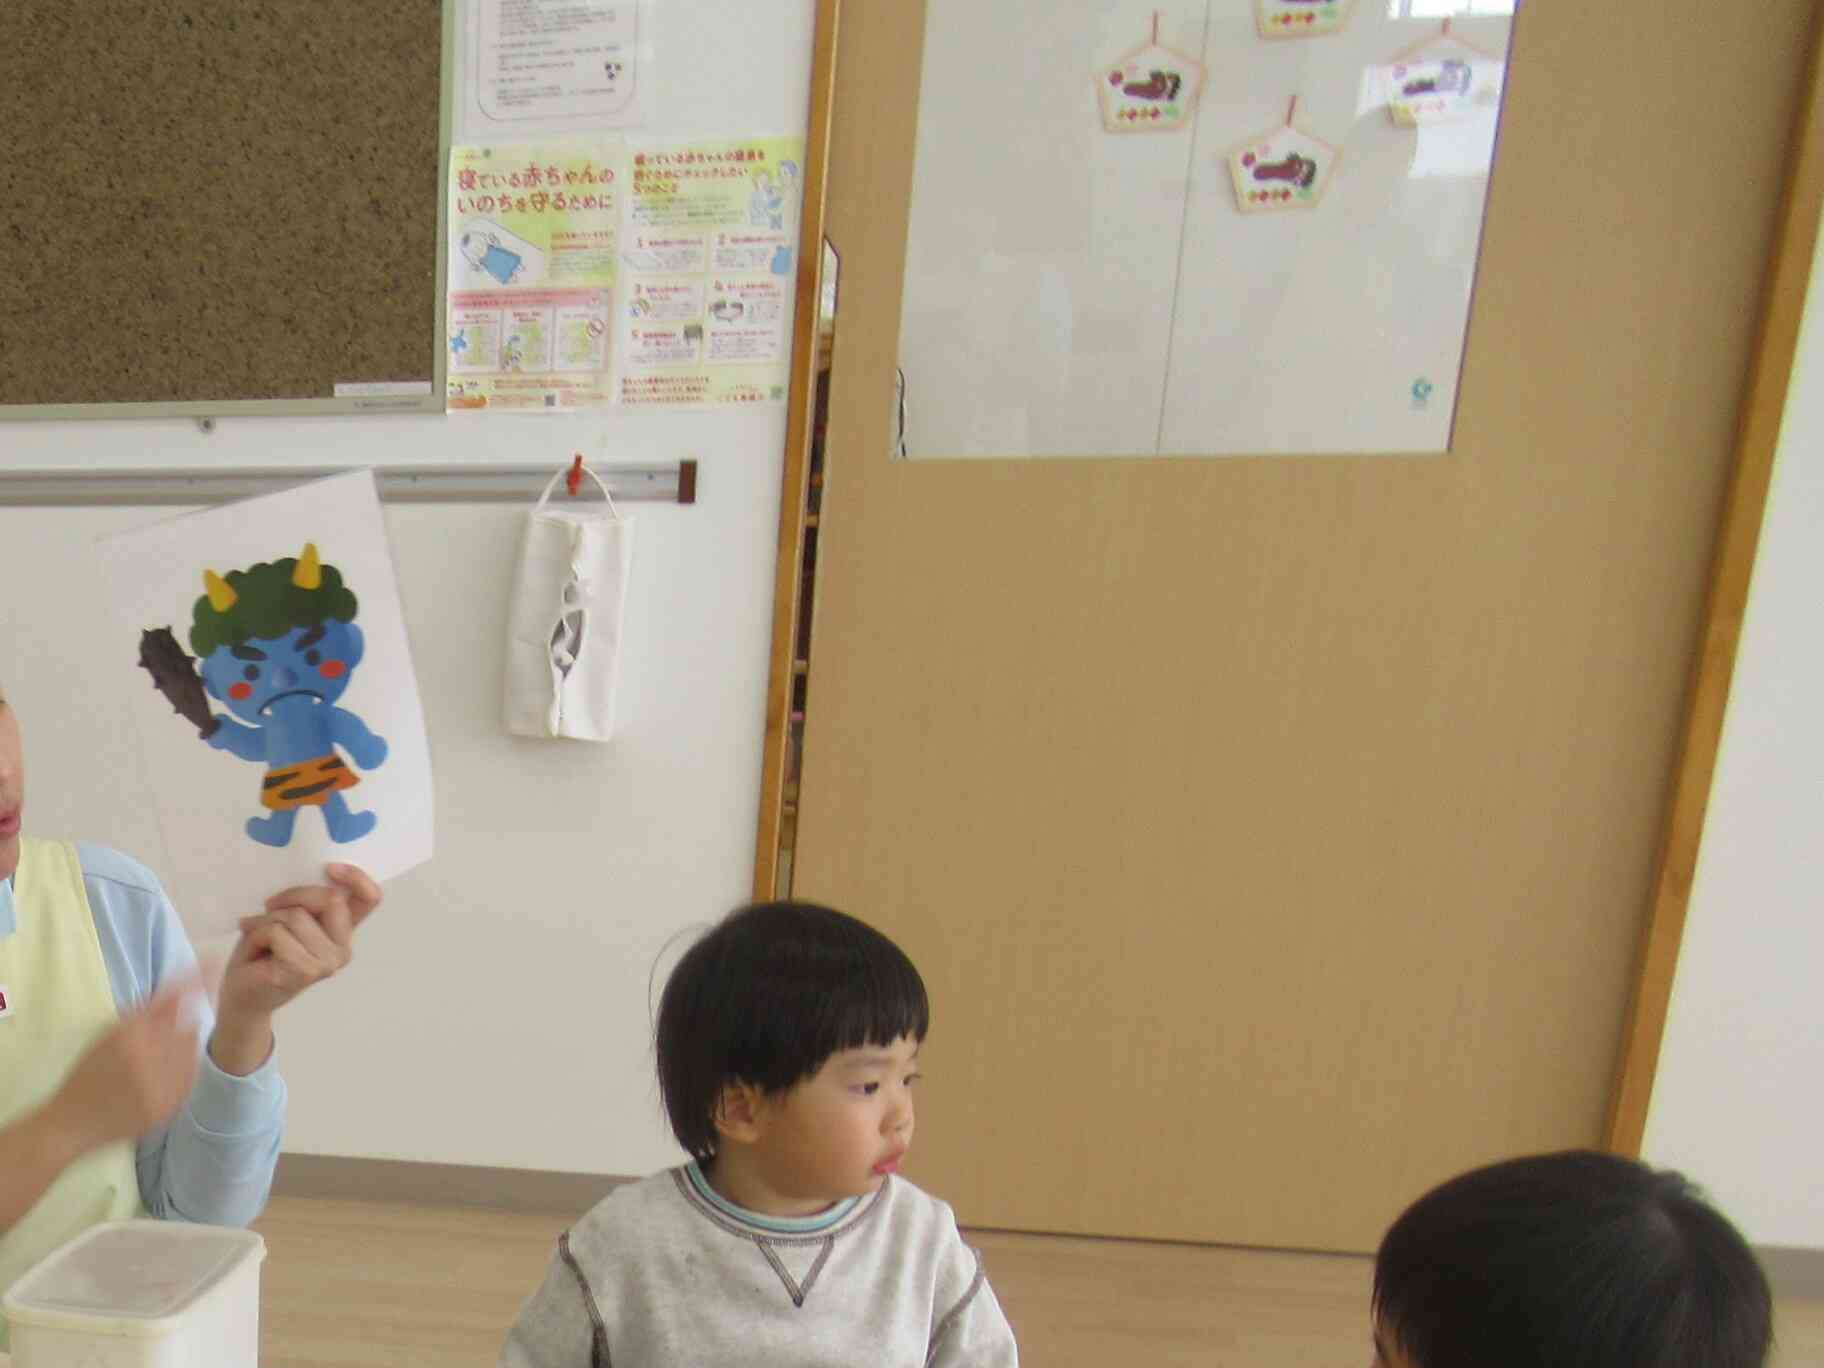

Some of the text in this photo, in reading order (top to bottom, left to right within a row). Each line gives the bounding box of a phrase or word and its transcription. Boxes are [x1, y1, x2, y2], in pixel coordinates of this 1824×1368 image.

[457, 161, 614, 191] 寝ている赤ちゃんの
[457, 191, 612, 214] いのちを守るために
